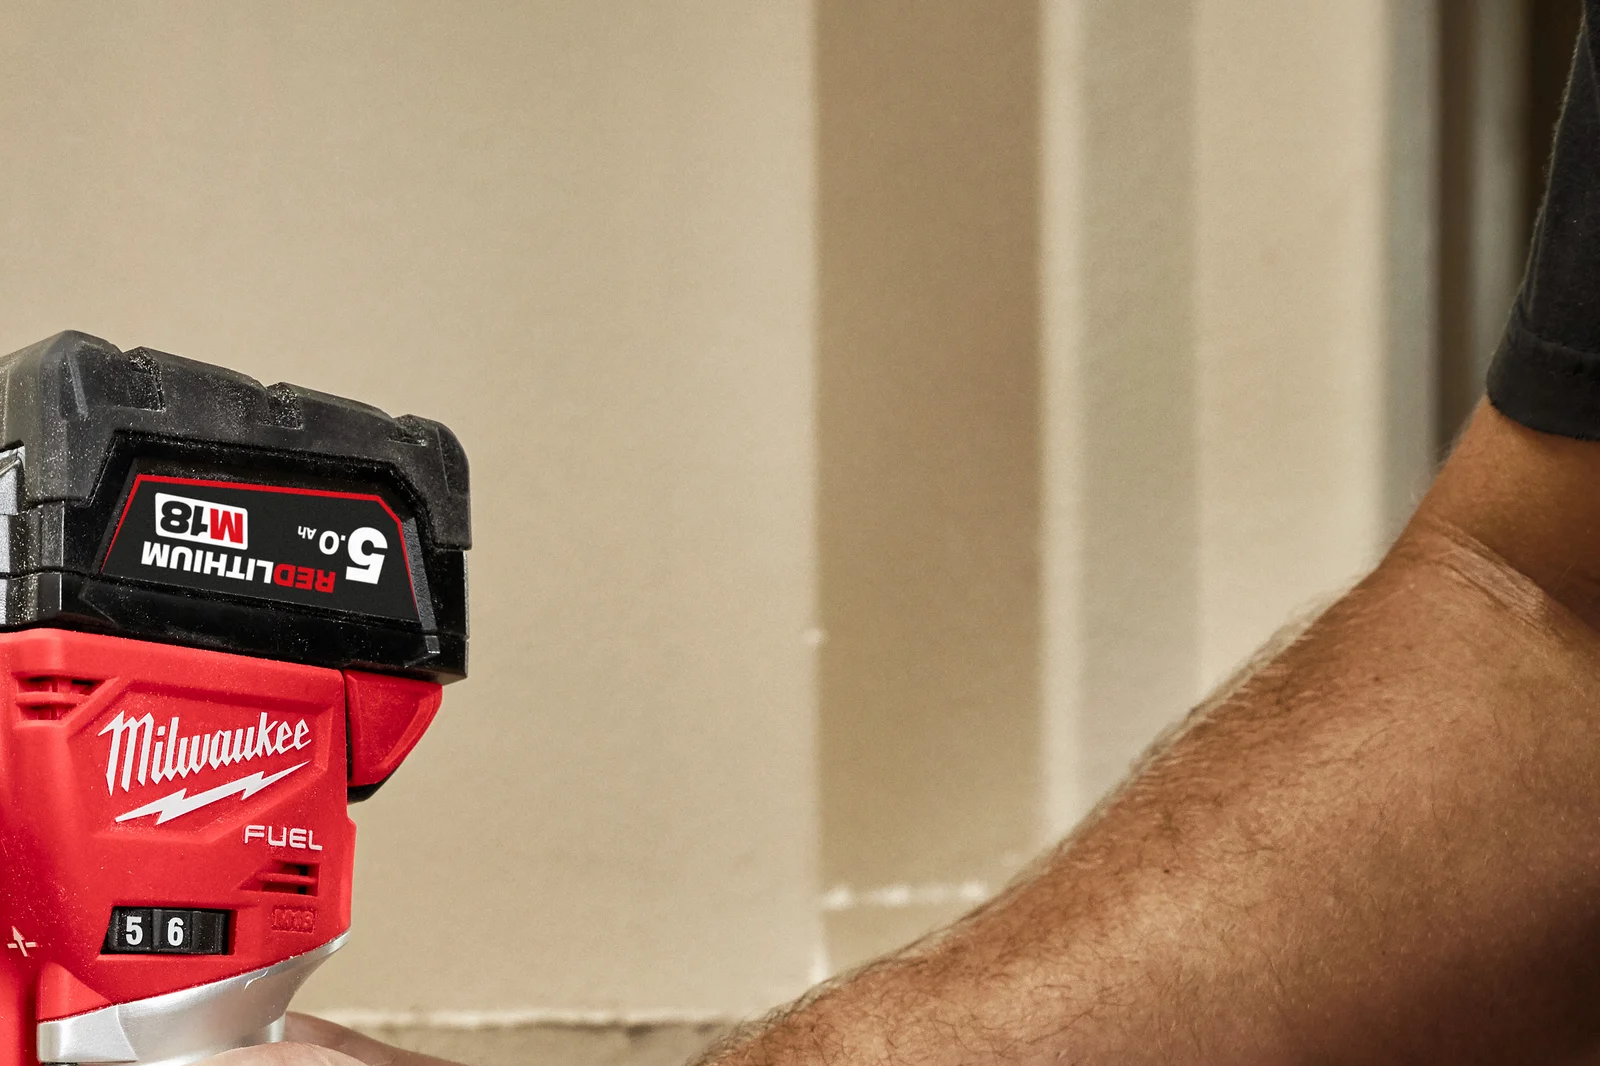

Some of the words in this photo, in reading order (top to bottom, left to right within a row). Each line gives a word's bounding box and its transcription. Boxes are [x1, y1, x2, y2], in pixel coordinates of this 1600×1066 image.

[160, 500, 244, 544] M18
[297, 525, 317, 540] Ah
[141, 541, 336, 593] REDLITHIUM
[318, 526, 388, 584] 5.0
[97, 710, 312, 796] Milwaukee
[244, 825, 323, 851] FUEL
[125, 916, 143, 945] 5
[167, 917, 185, 946] 6
